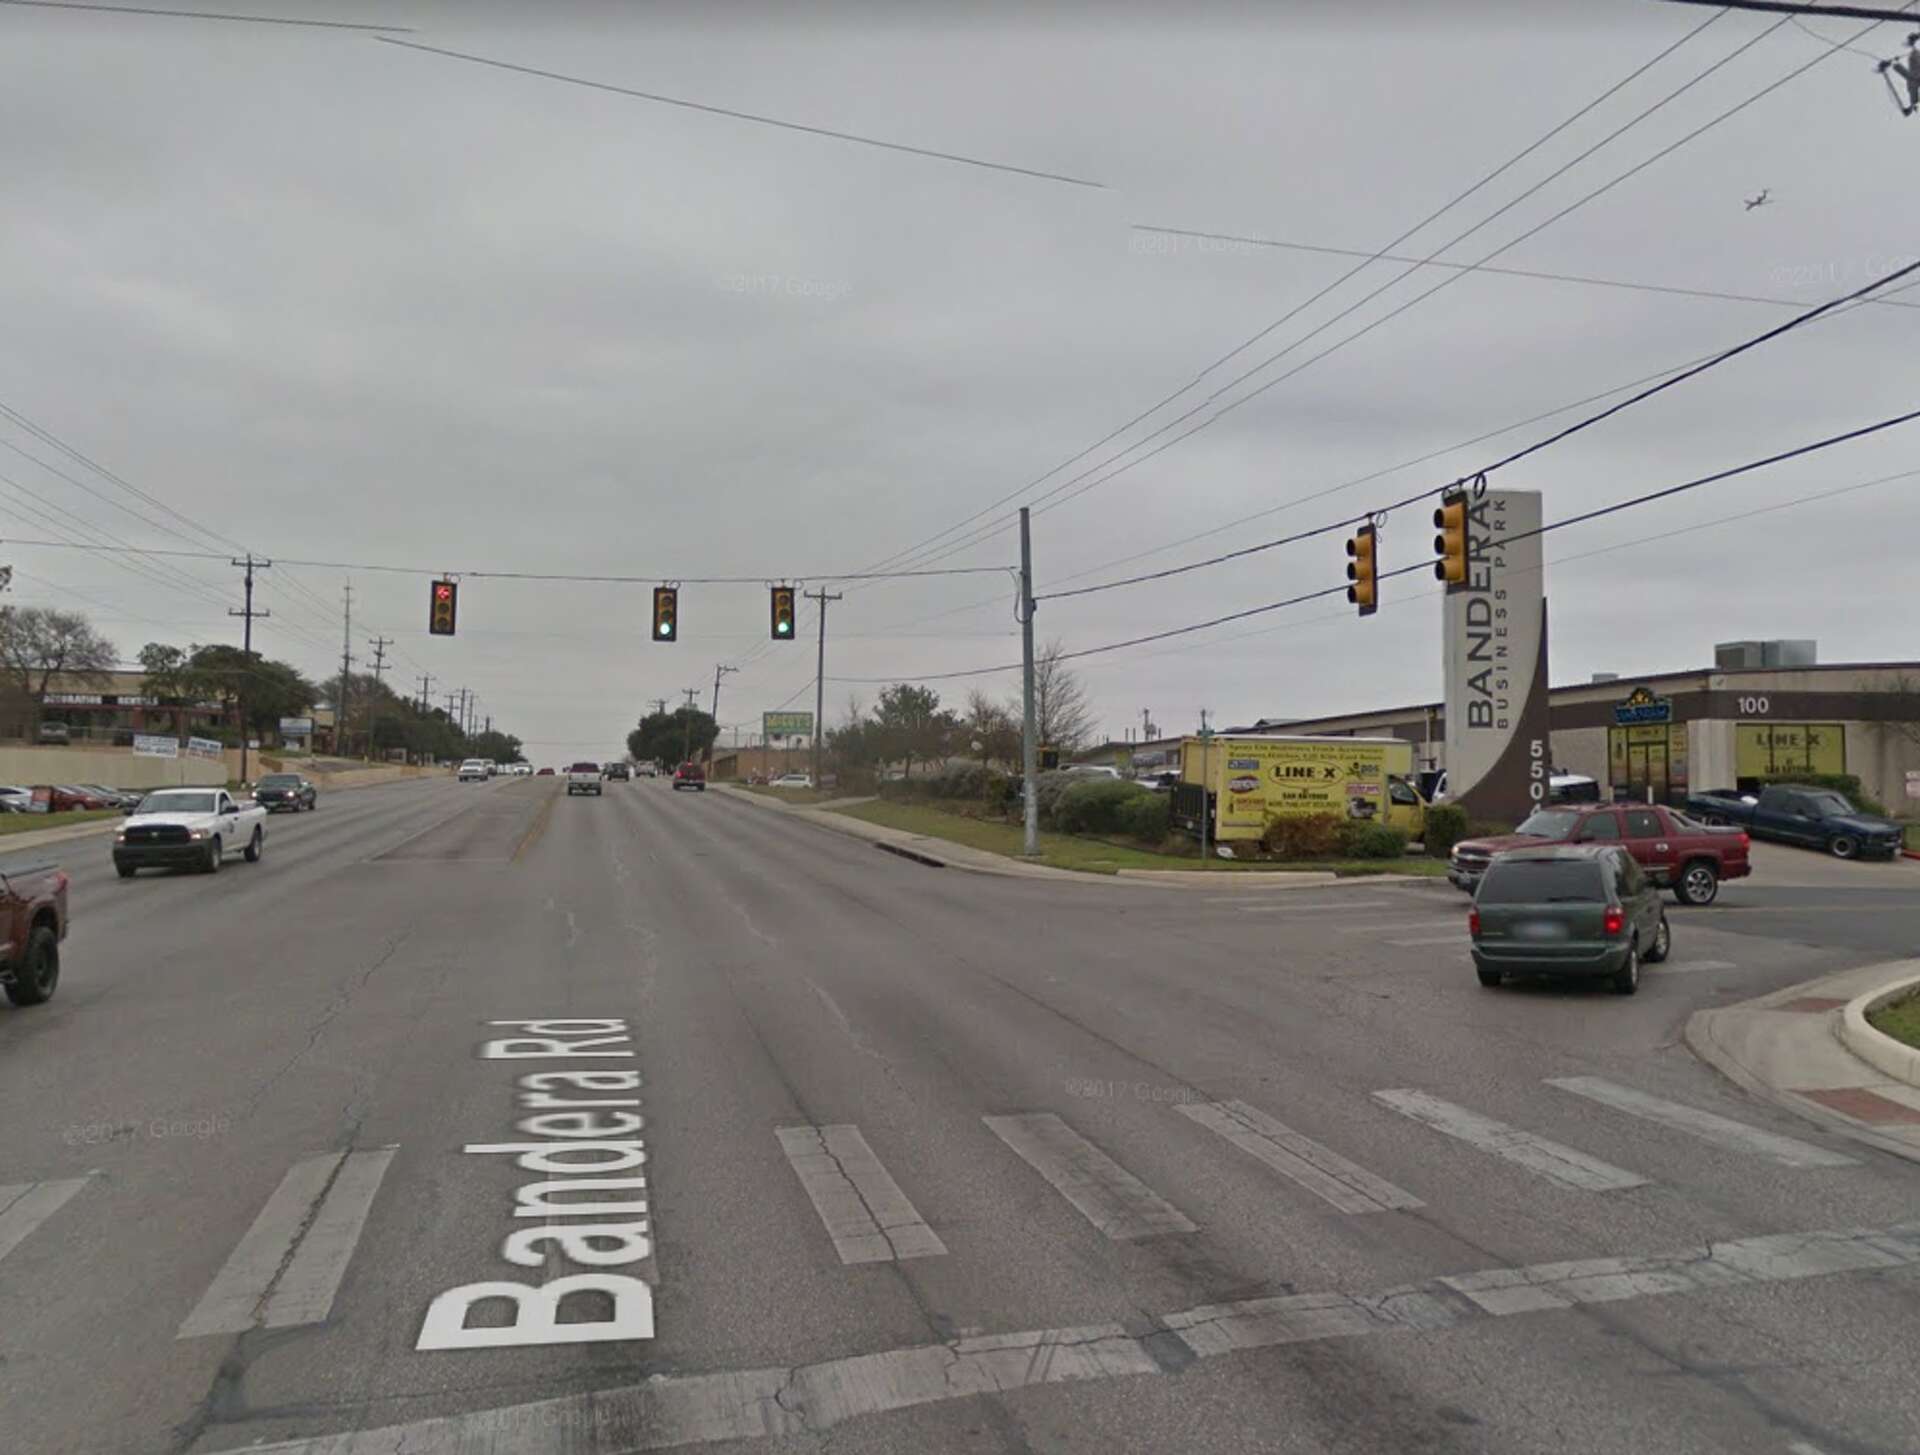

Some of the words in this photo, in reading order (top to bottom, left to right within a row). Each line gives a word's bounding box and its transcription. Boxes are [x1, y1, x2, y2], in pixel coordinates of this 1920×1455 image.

[1493, 500, 1506, 568] PARK
[1466, 499, 1493, 729] BANDERA
[1495, 589, 1508, 729] BUSINESS
[1738, 697, 1769, 714] 100
